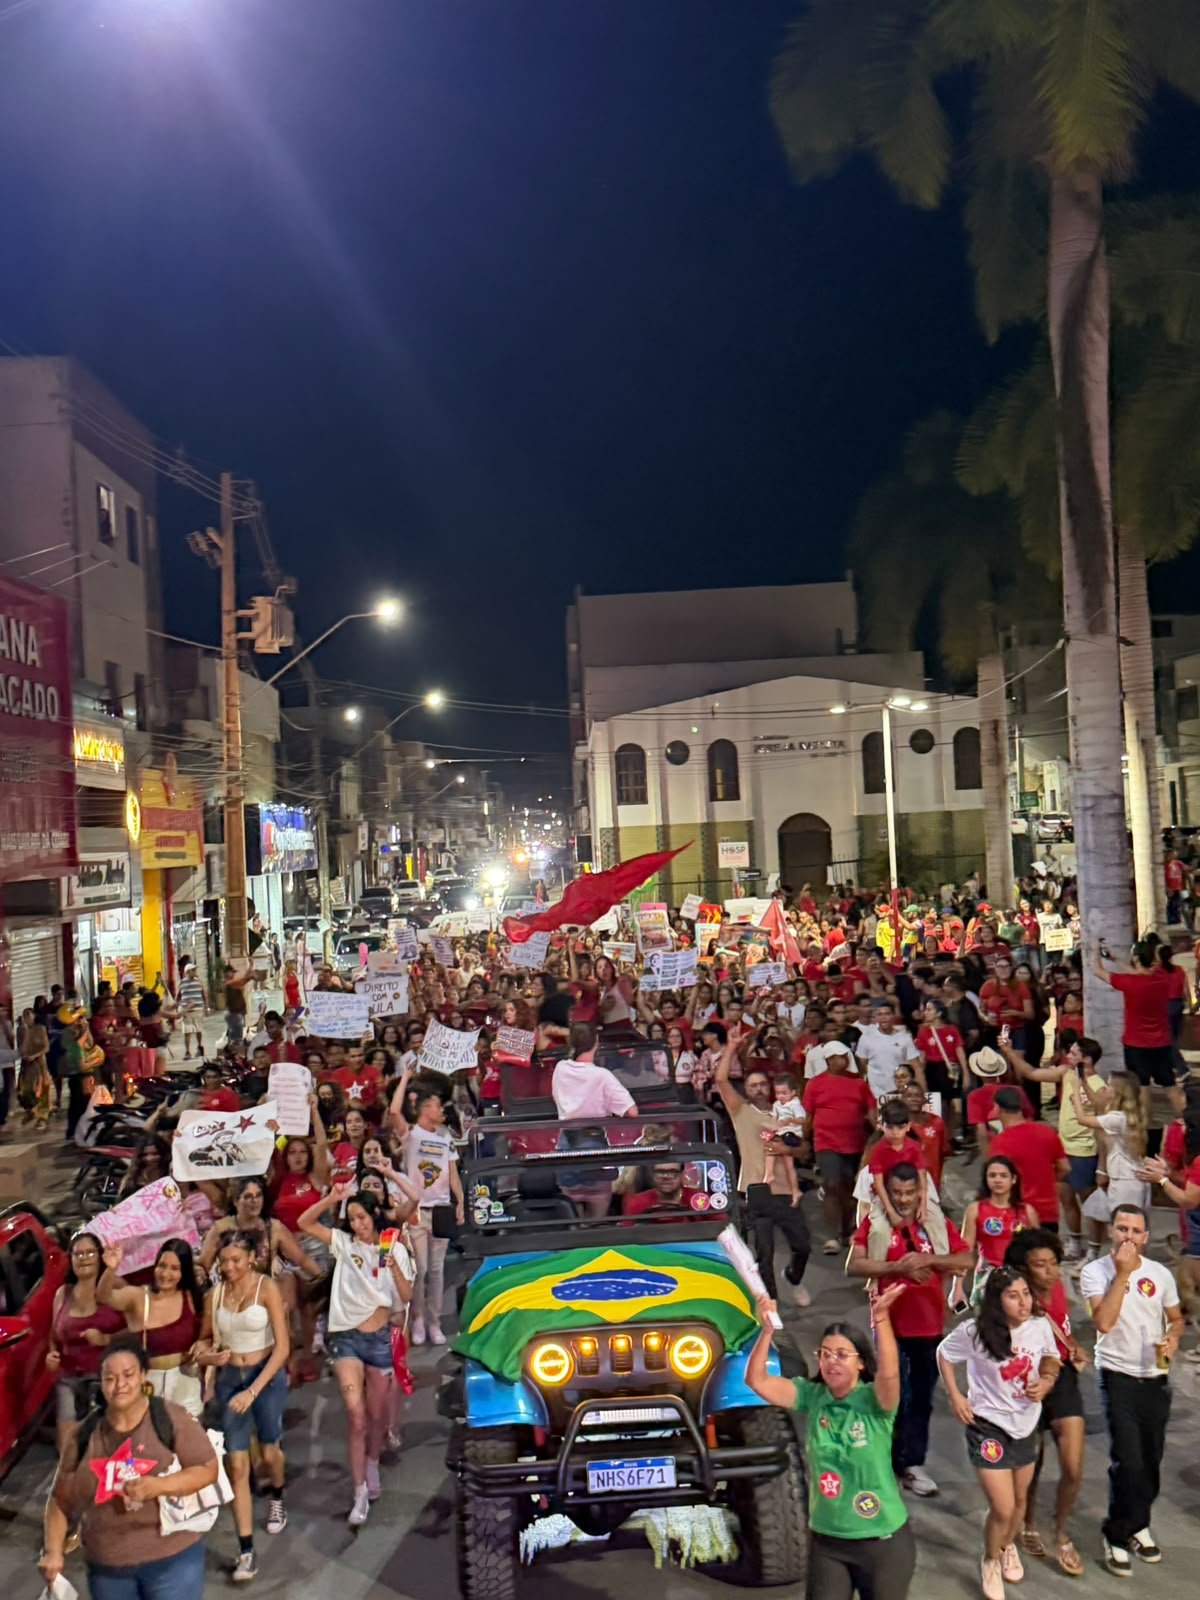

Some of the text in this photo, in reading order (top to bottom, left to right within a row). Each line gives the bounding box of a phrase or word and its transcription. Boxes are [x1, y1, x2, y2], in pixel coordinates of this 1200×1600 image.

[365, 982, 399, 993] DIREITO
[372, 993, 388, 1001] COM
[596, 1468, 666, 1488] NHS6F71
